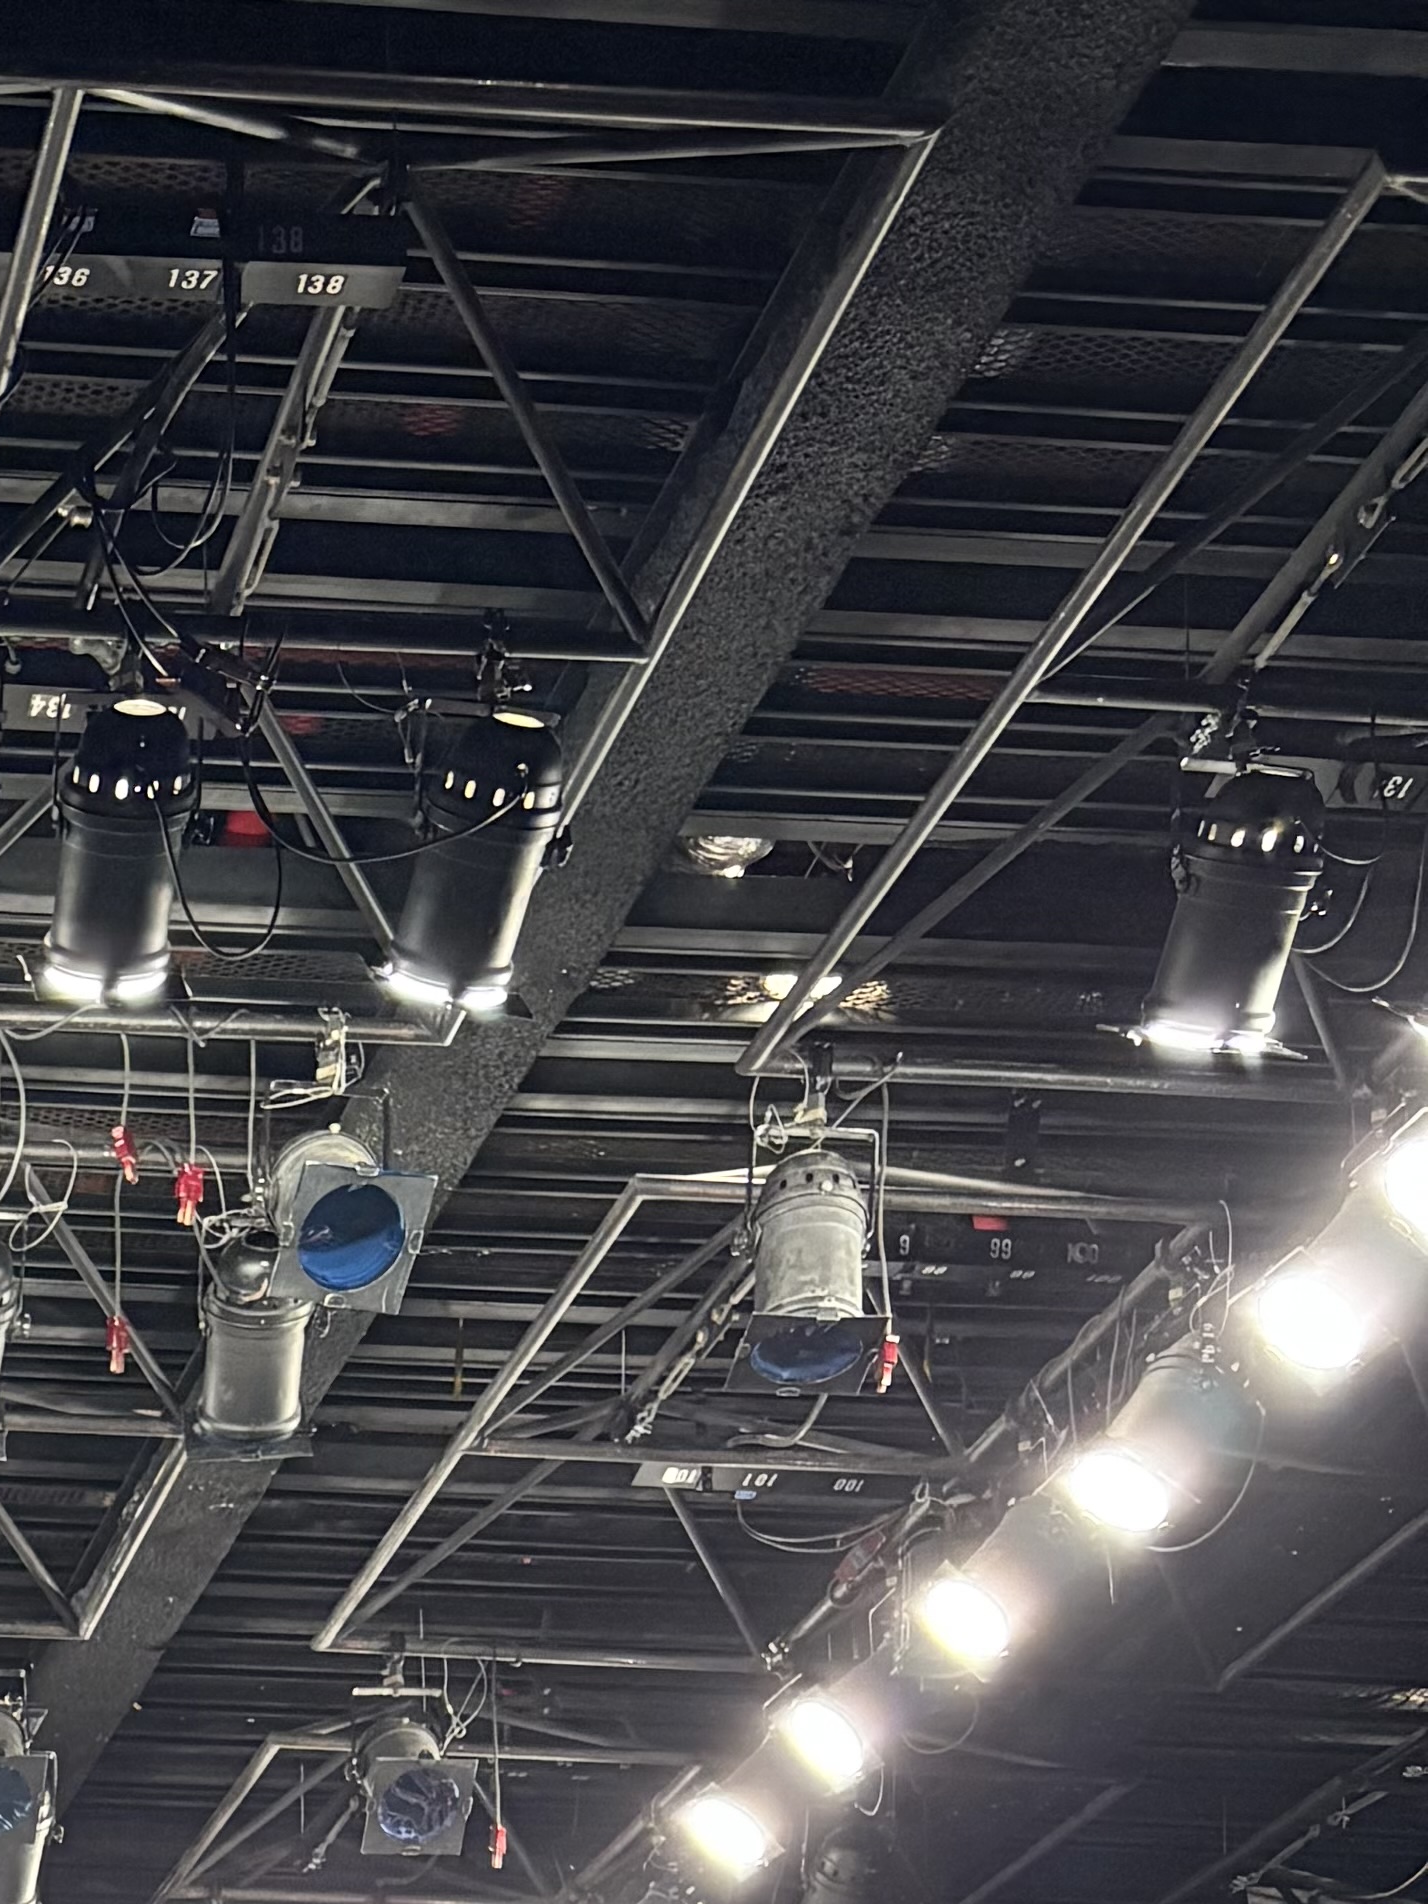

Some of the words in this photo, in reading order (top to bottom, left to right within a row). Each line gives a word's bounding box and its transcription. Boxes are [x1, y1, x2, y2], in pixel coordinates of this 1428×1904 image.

[43, 264, 90, 288] 136
[167, 268, 219, 290] 137
[296, 272, 345, 295] 138
